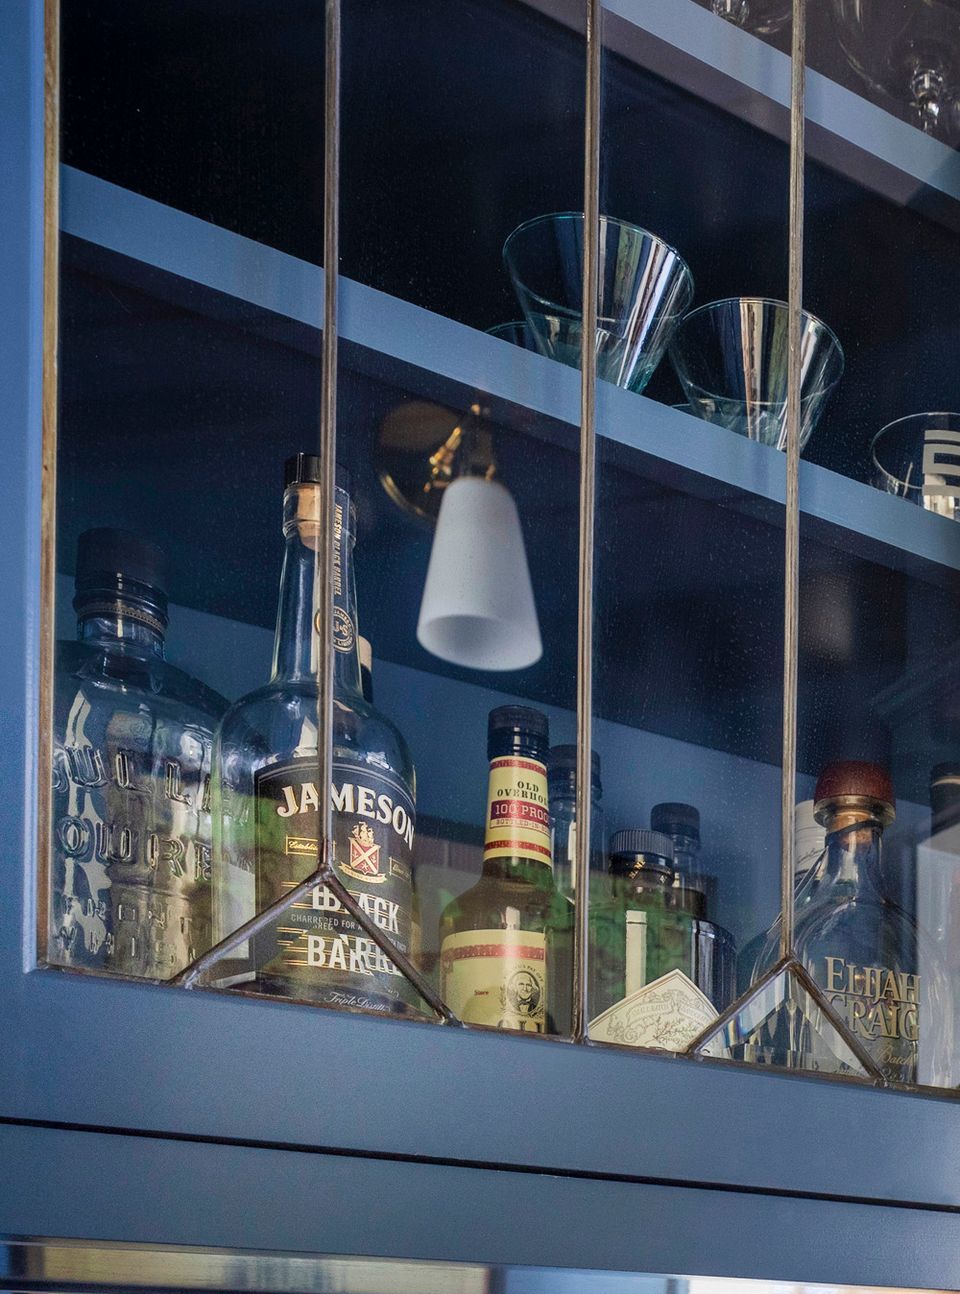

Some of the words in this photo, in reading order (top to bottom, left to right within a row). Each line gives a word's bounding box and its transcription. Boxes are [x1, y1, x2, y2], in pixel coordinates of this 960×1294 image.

[495, 803, 517, 816] 100
[517, 780, 540, 793] OLD
[276, 782, 416, 851] JAMESON
[312, 884, 401, 935] BACK
[824, 956, 922, 1005] ELIJAH
